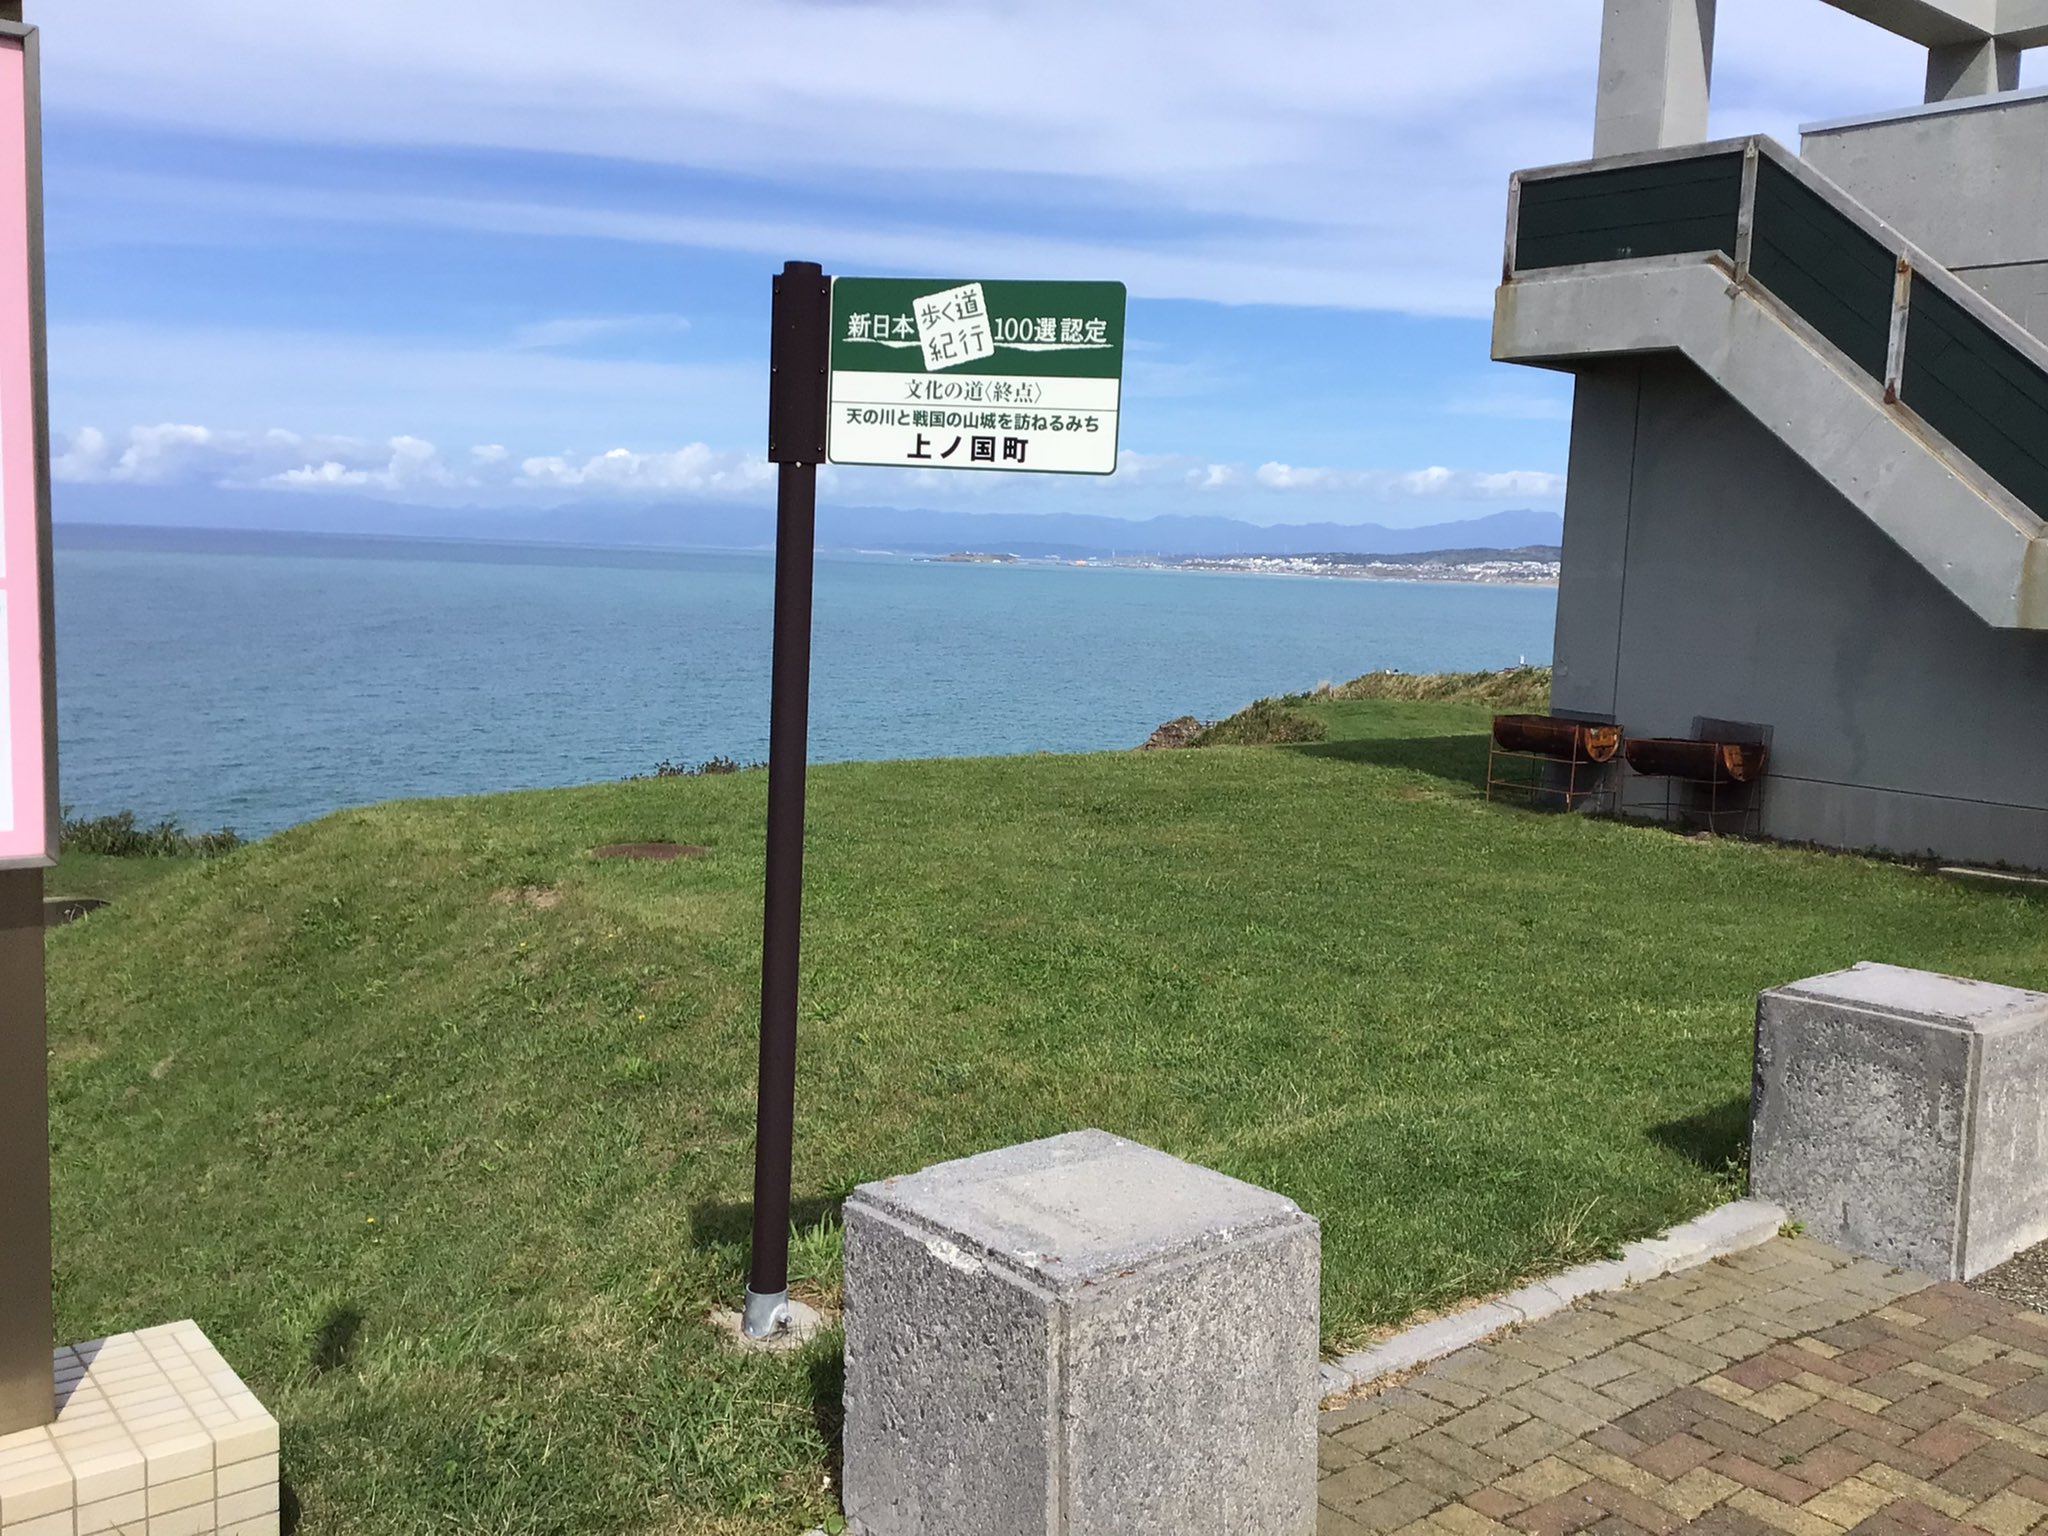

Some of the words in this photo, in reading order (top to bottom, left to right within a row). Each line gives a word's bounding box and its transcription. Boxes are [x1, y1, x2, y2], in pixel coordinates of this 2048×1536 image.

[920, 289, 983, 330] 歩く道
[848, 312, 914, 339] 新日本
[994, 317, 1107, 343] 100選認定
[928, 324, 984, 362] 紀行
[846, 407, 1099, 432] 天の川と戦国の山城を訪ねるみち
[906, 433, 1029, 463] 上ノ国町
